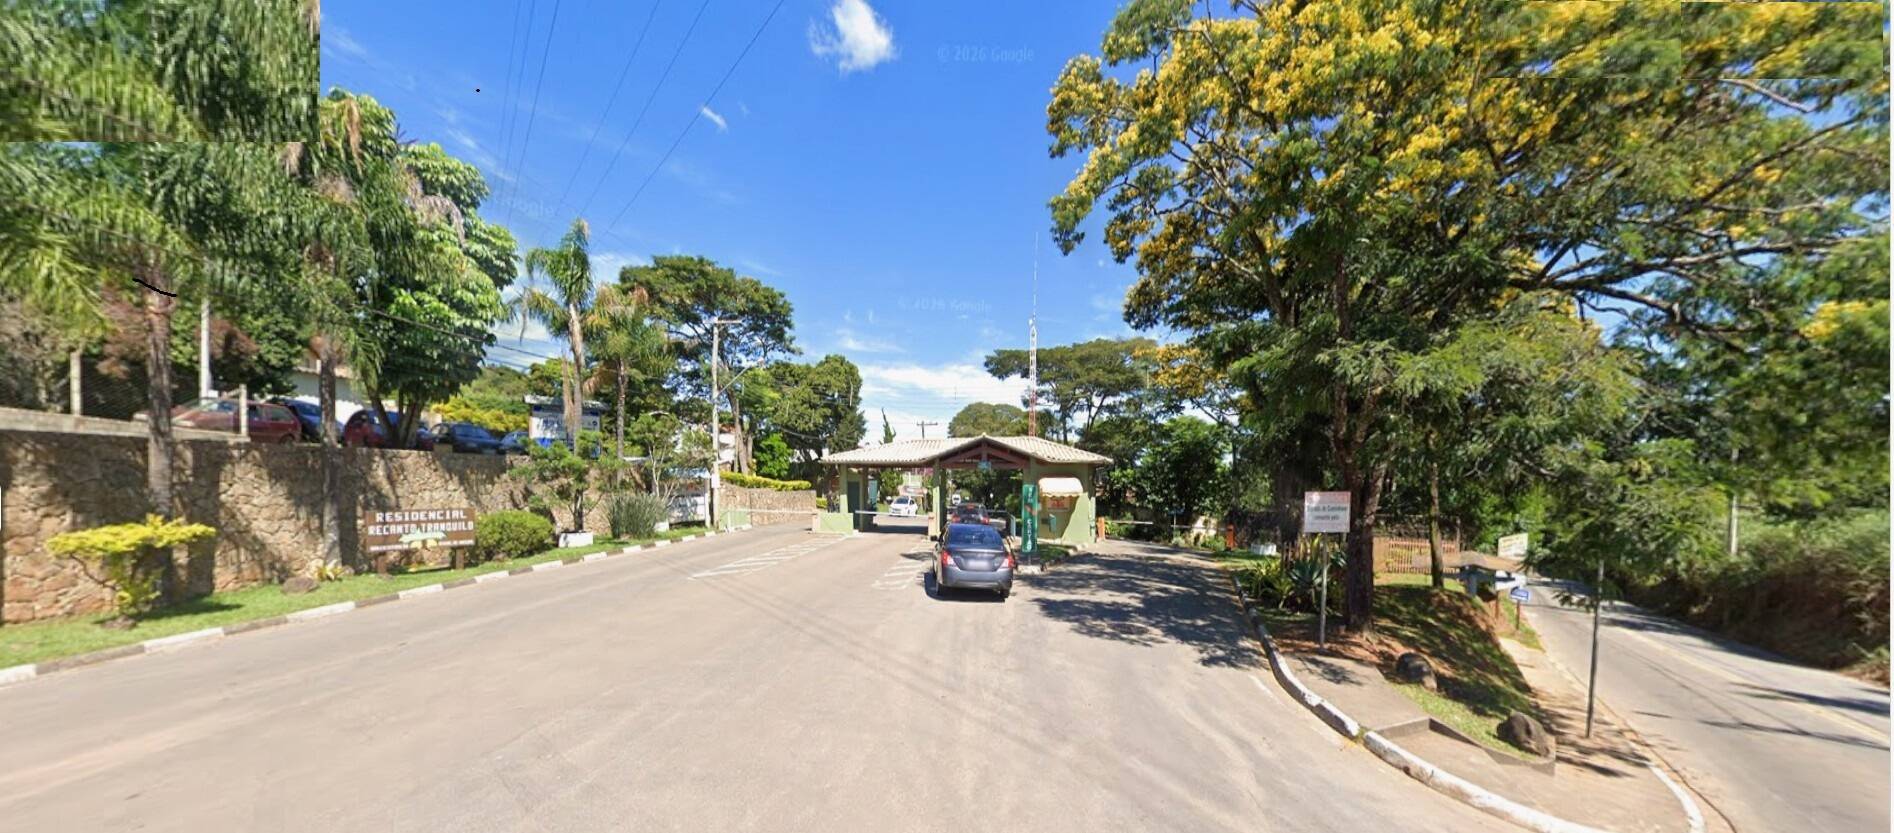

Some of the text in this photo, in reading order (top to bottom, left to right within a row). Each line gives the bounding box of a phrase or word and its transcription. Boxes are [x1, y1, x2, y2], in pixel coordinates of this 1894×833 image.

[376, 510, 467, 522] RESIDENCIAL
[368, 521, 474, 535] RECANTO TRANQUILO
